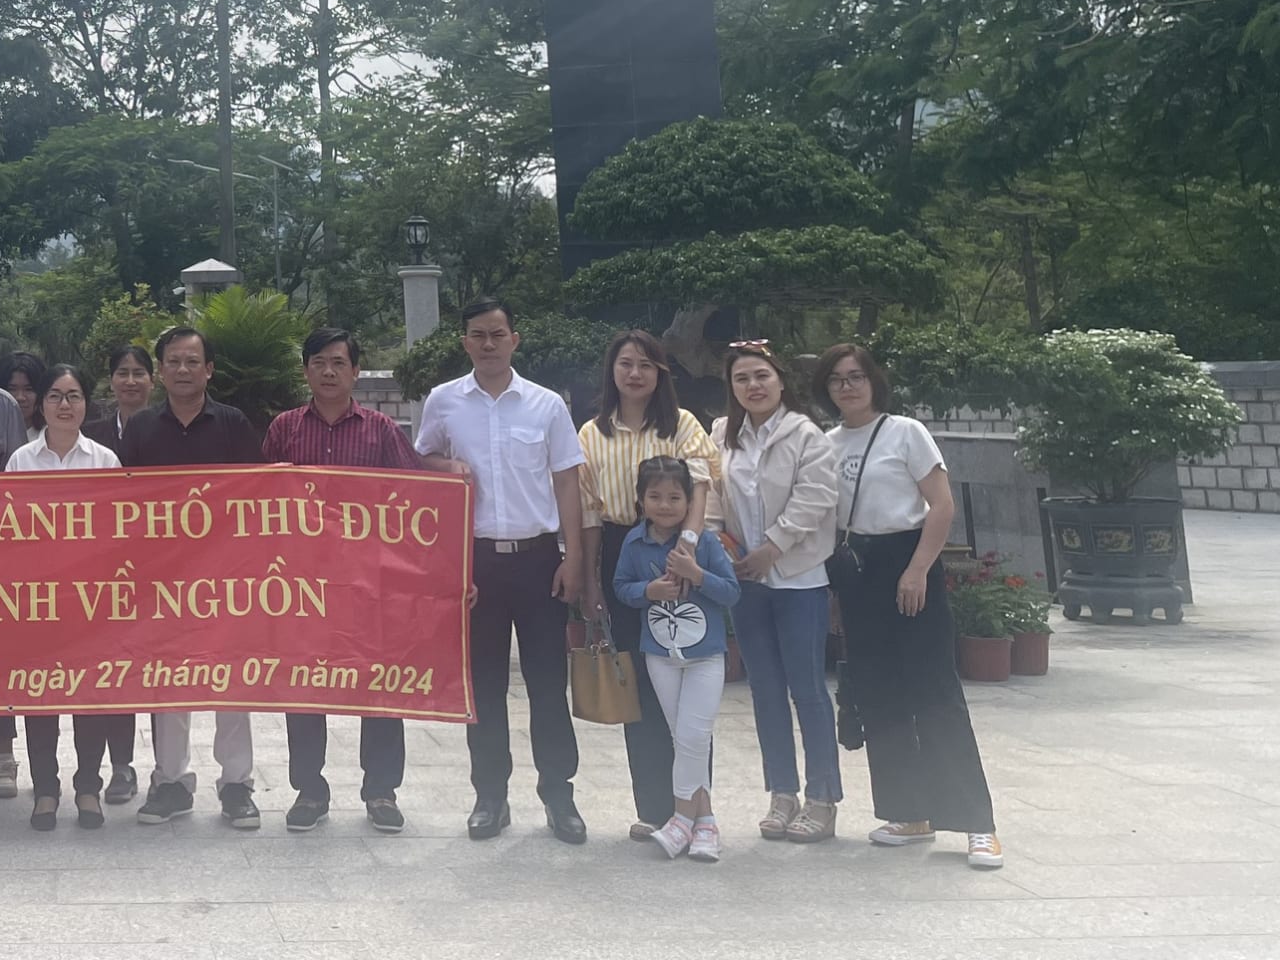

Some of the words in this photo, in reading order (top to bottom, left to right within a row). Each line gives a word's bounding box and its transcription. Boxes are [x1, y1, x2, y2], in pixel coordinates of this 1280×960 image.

[111, 482, 213, 539] PHỐ
[226, 482, 326, 537] THỦ
[339, 492, 440, 546] ĐỨC
[72, 559, 137, 621] VỀ
[151, 555, 328, 620] NGUỒN
[7, 661, 87, 697] ngày
[95, 660, 133, 688] 27
[142, 658, 231, 693] tháng
[242, 658, 281, 686] 07
[290, 659, 359, 690] năm
[367, 663, 434, 696] 2024
